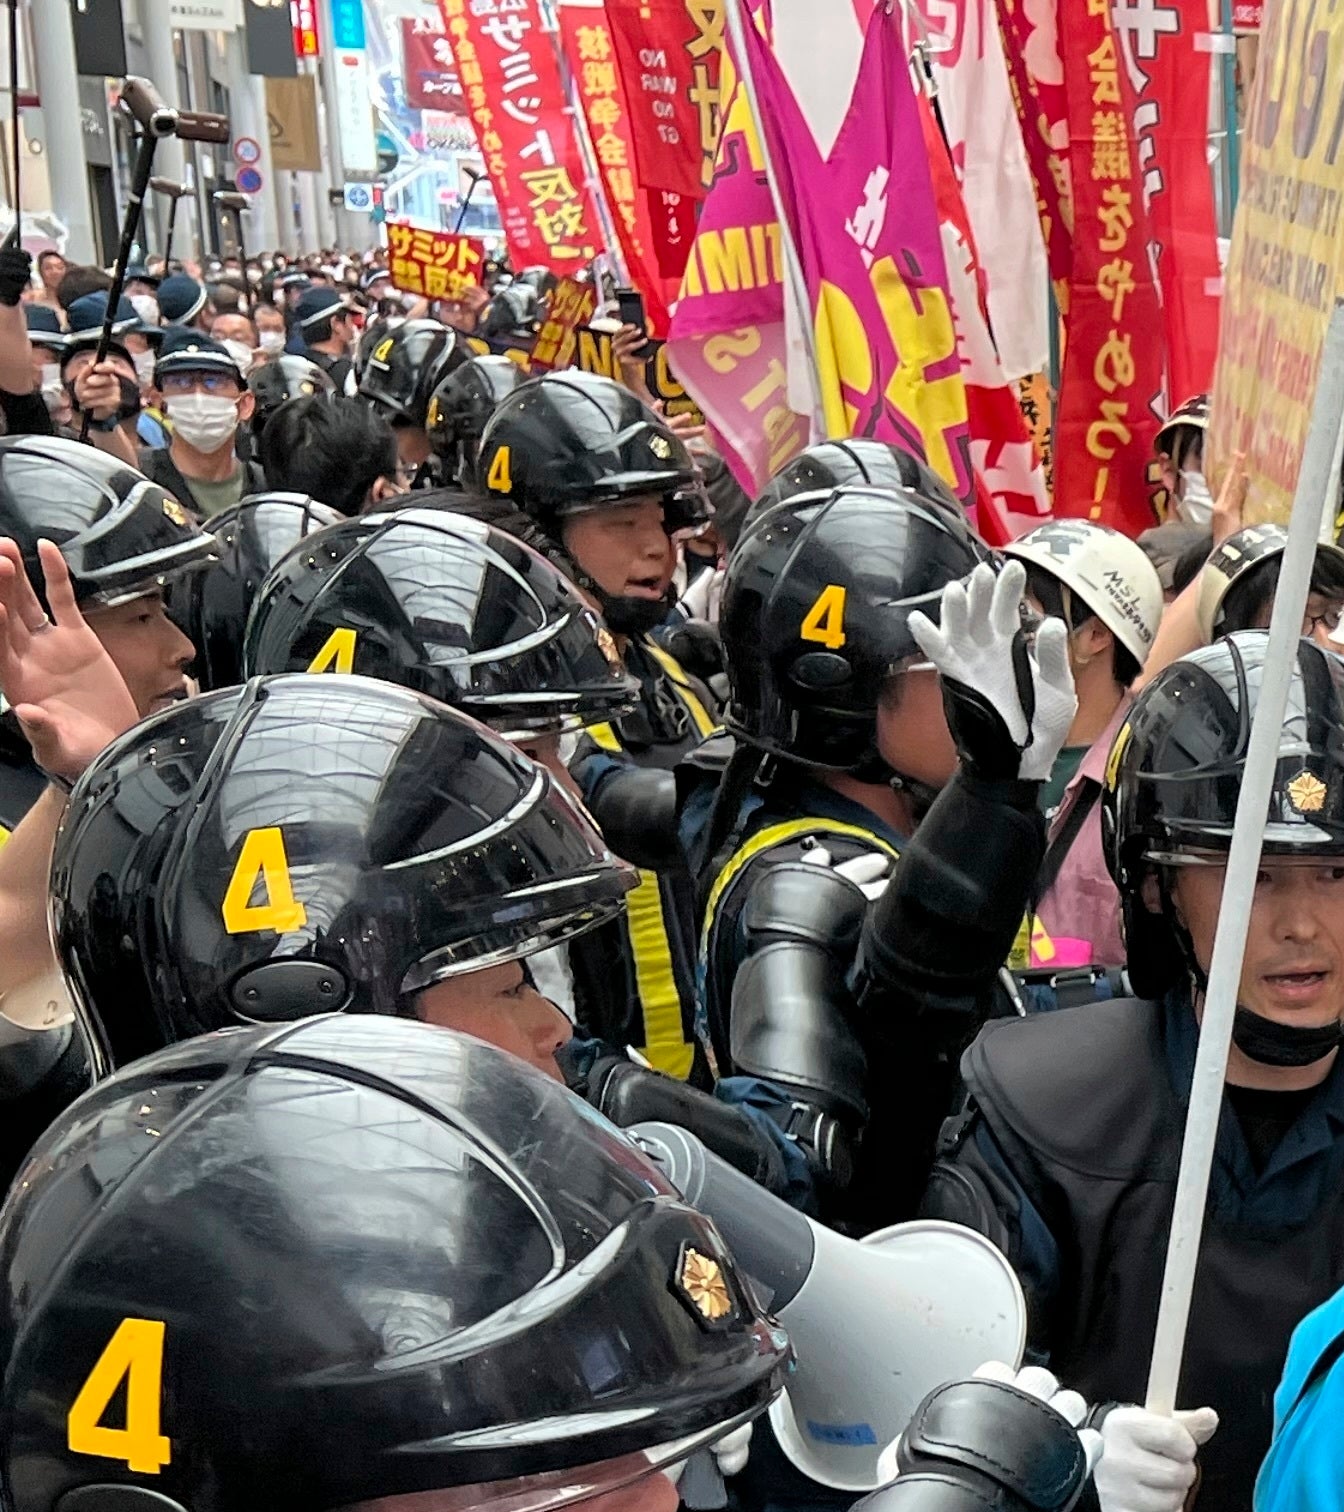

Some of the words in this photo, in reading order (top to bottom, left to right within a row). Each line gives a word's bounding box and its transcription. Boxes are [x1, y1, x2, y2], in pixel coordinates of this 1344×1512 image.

[389, 226, 480, 272] サミット
[487, 445, 513, 494] 4
[800, 584, 847, 650] 4
[221, 827, 308, 935] 4
[67, 1317, 171, 1475] 4
